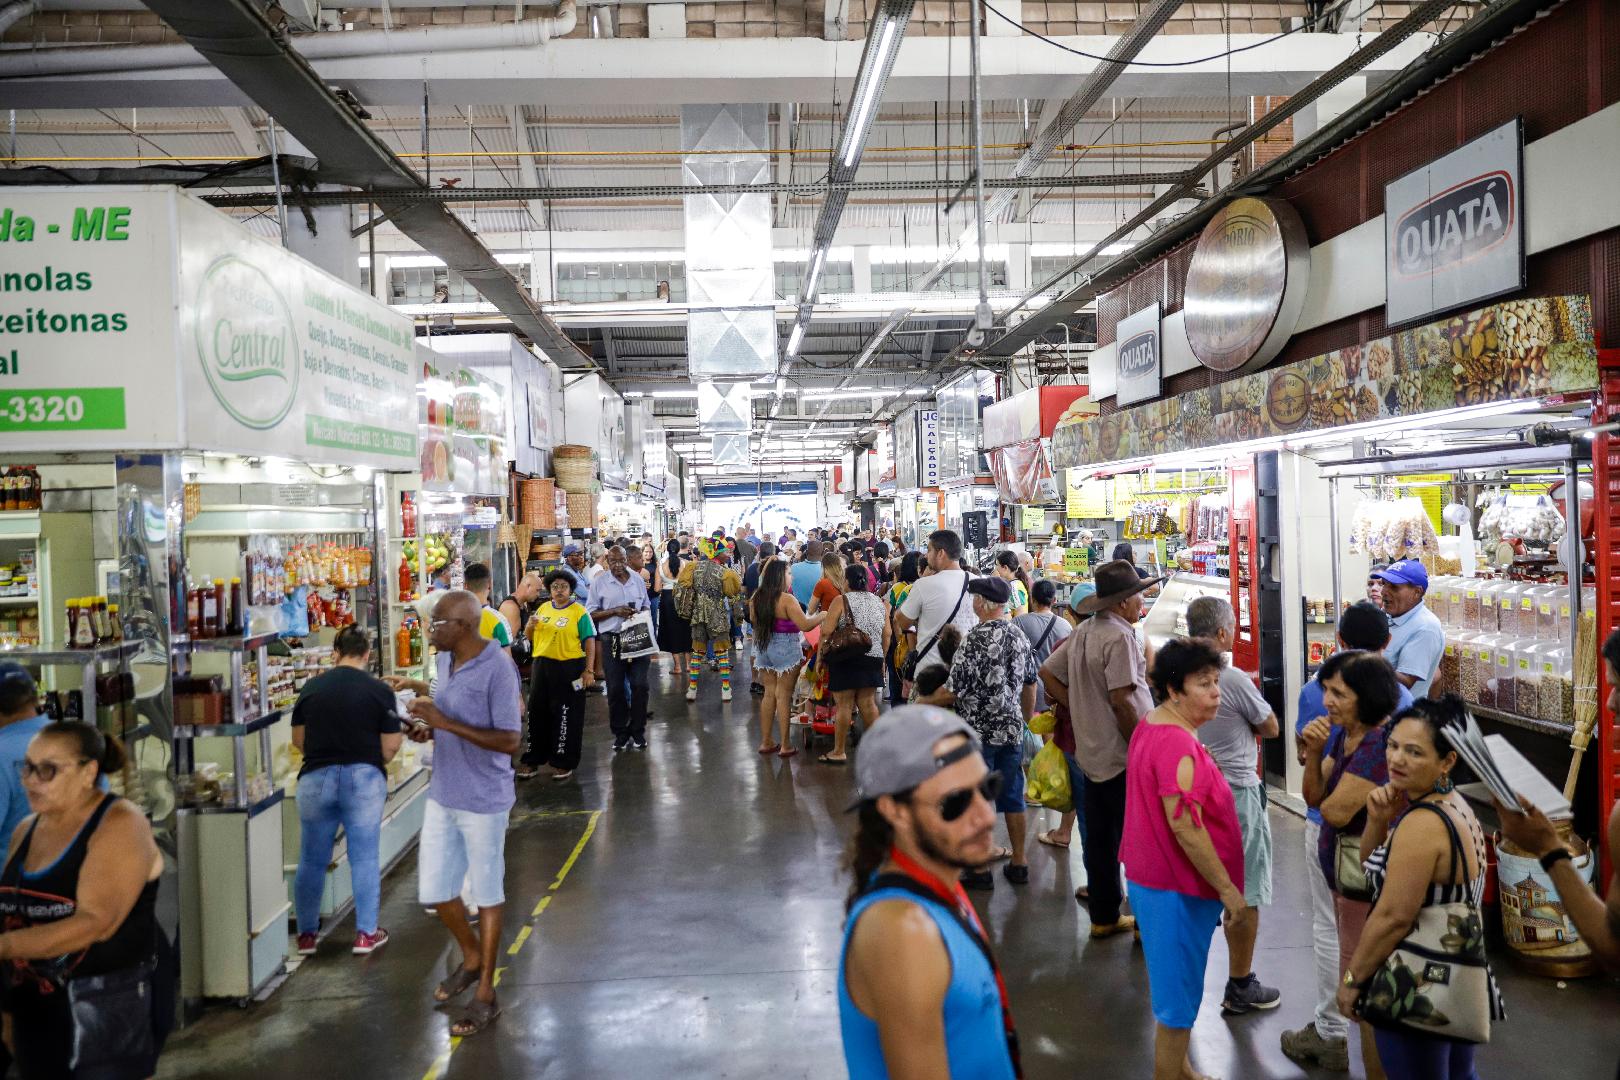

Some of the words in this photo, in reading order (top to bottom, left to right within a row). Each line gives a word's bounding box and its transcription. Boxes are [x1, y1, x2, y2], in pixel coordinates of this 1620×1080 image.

[71, 207, 131, 241] ME
[1401, 181, 1502, 270] QUATÁ
[0, 266, 92, 291] nolas
[0, 308, 128, 333] eitonas
[213, 319, 286, 368] Central
[1121, 335, 1154, 376] QUATÁ
[923, 412, 938, 421] JG
[927, 423, 937, 485] CALÇADOS
